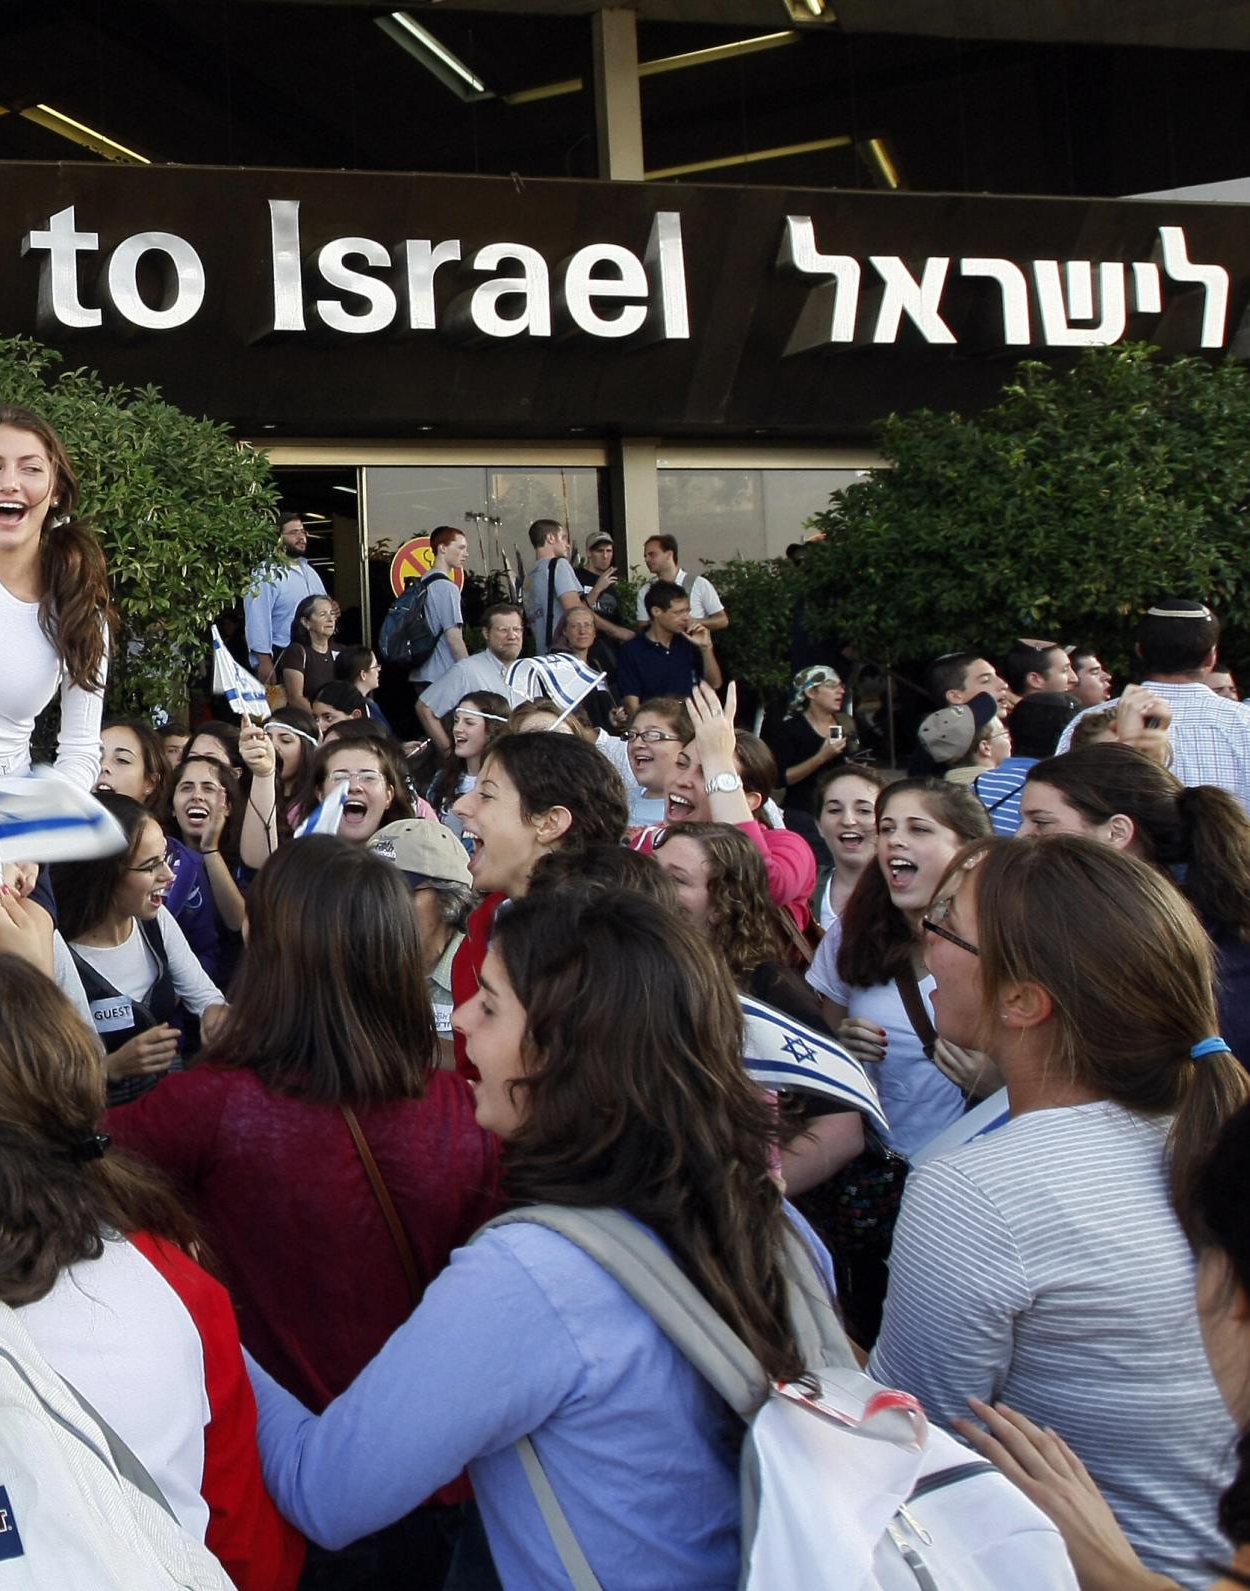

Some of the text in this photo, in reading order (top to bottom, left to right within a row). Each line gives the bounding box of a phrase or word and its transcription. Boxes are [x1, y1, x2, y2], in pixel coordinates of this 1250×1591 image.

[26, 205, 206, 330] to
[268, 199, 690, 339] Israel
[785, 215, 1230, 349] לישראל
[94, 1005, 130, 1021] GUEST
